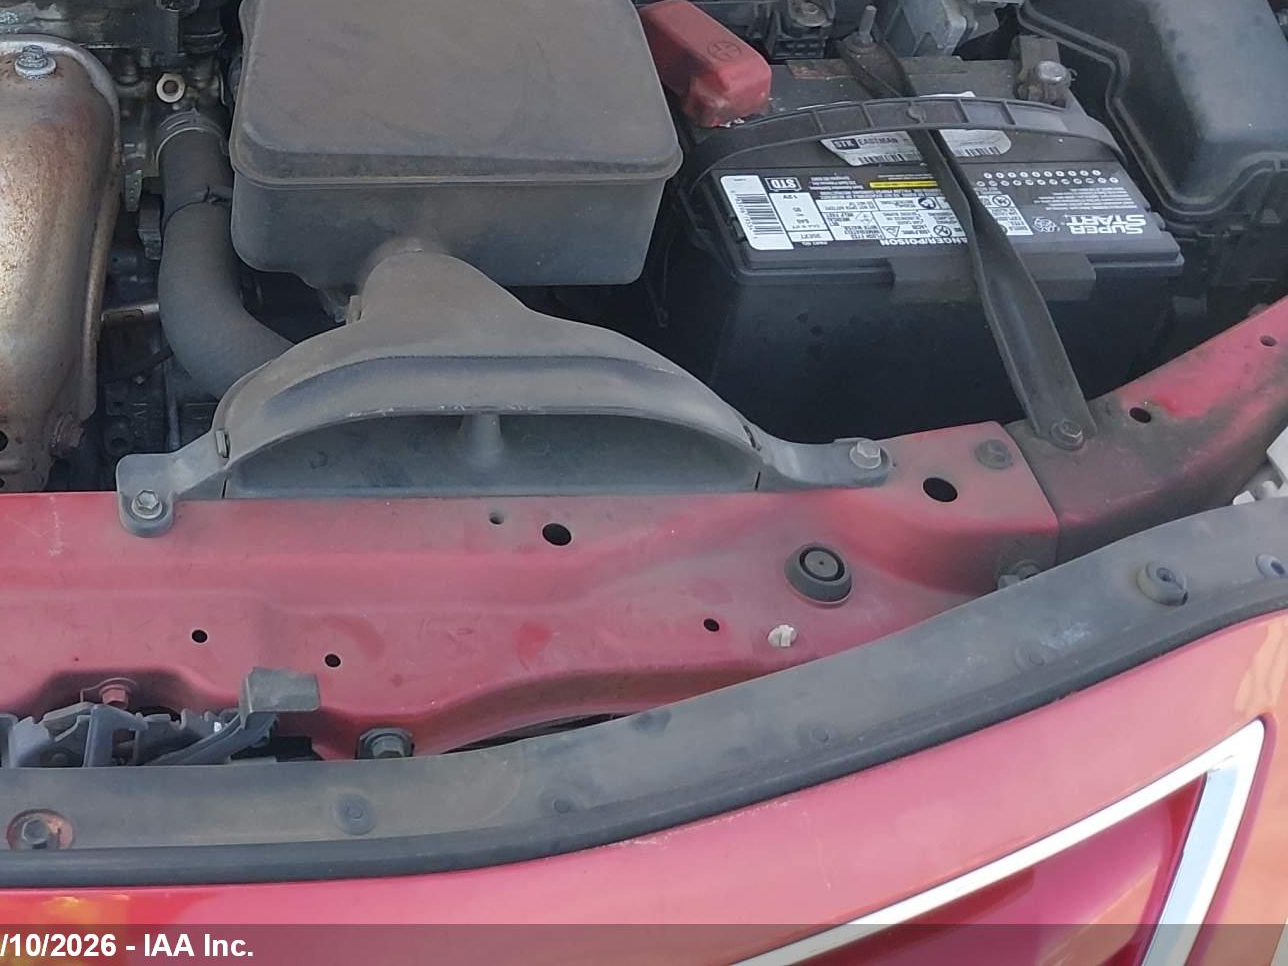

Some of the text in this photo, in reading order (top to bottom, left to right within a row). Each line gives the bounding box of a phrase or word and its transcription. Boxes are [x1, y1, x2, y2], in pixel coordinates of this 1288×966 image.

[858, 136, 900, 146] EASTMAN
[770, 178, 796, 191] STD
[1066, 214, 1146, 226] START
[1069, 225, 1144, 235] SUPER
[879, 236, 968, 245] ANGER/POISON
